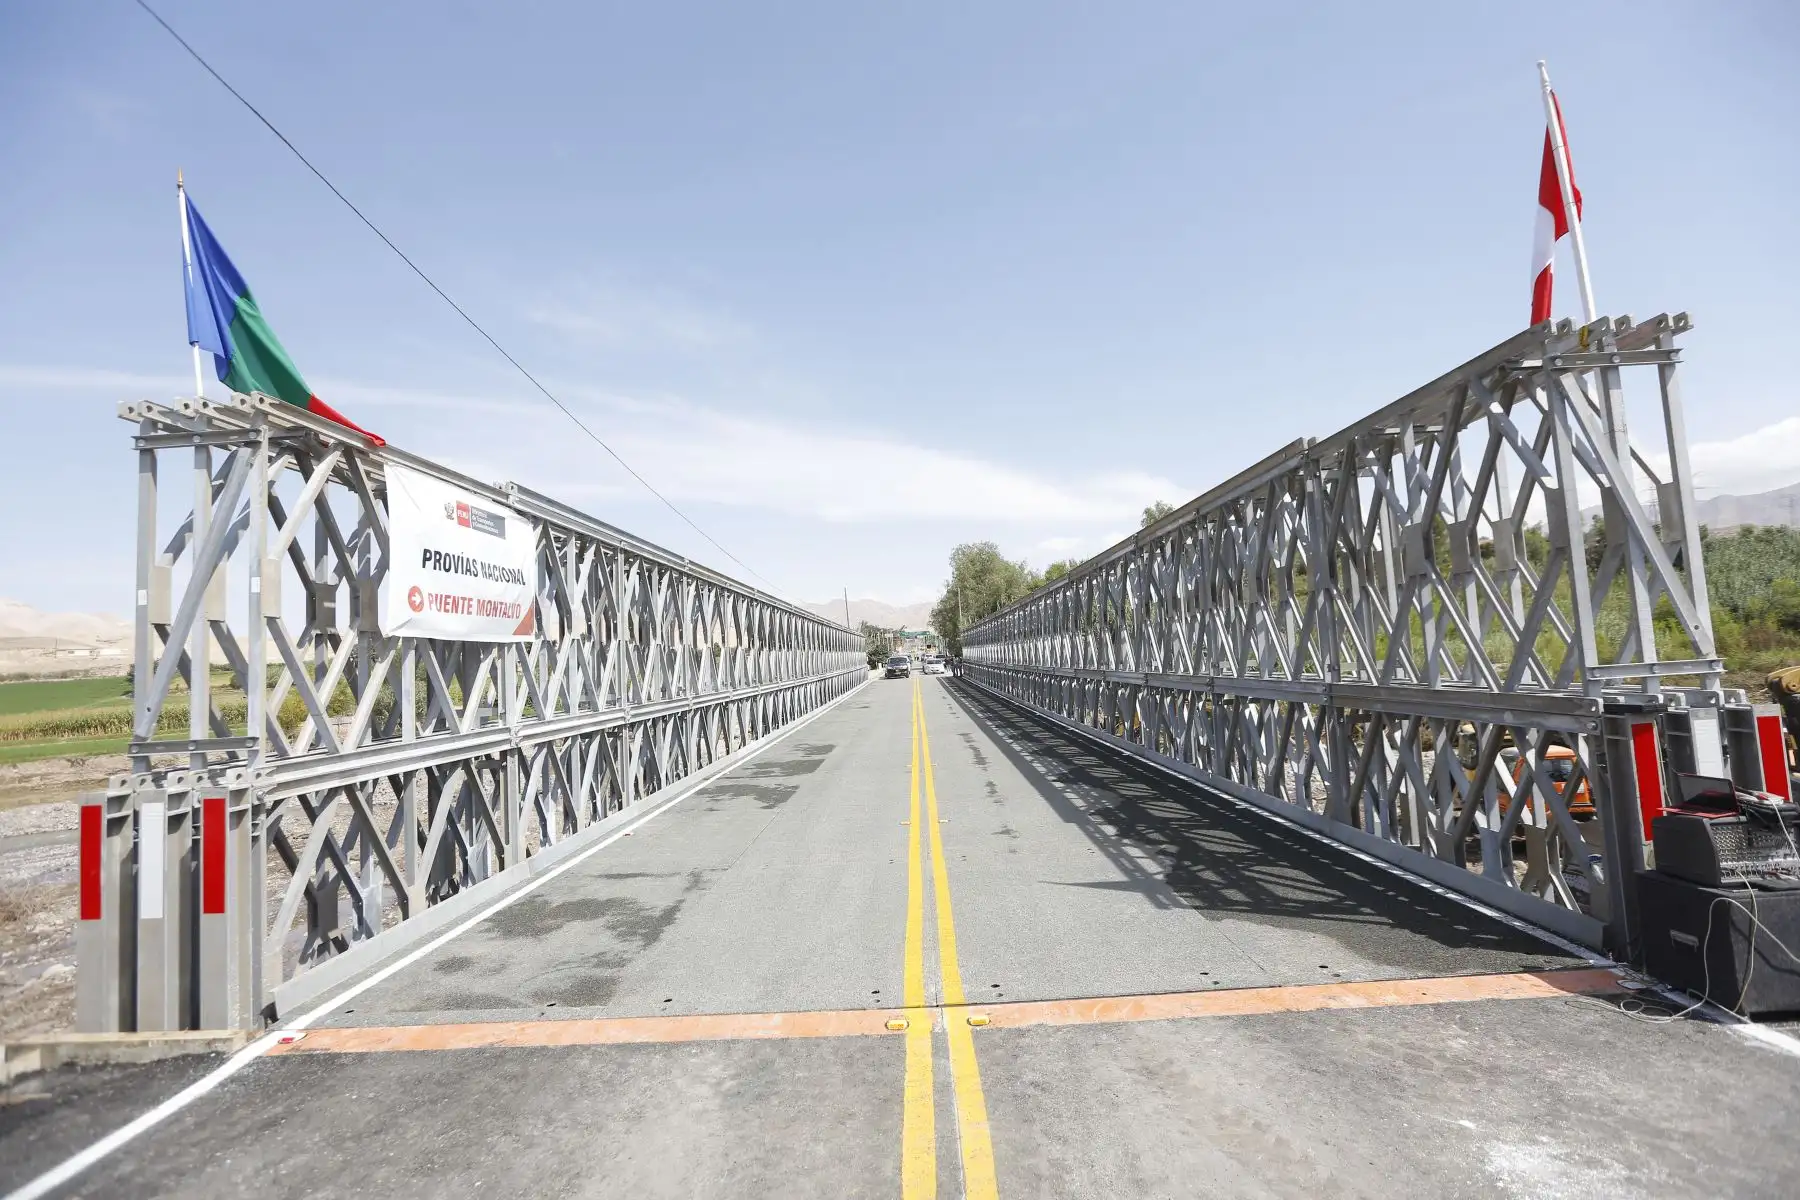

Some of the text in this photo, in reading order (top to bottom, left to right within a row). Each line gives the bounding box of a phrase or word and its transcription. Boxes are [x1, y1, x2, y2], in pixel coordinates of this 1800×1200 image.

[422, 548, 526, 586] PROVÍAS NACIONAL
[428, 592, 521, 619] PUENTE MONTALVO
